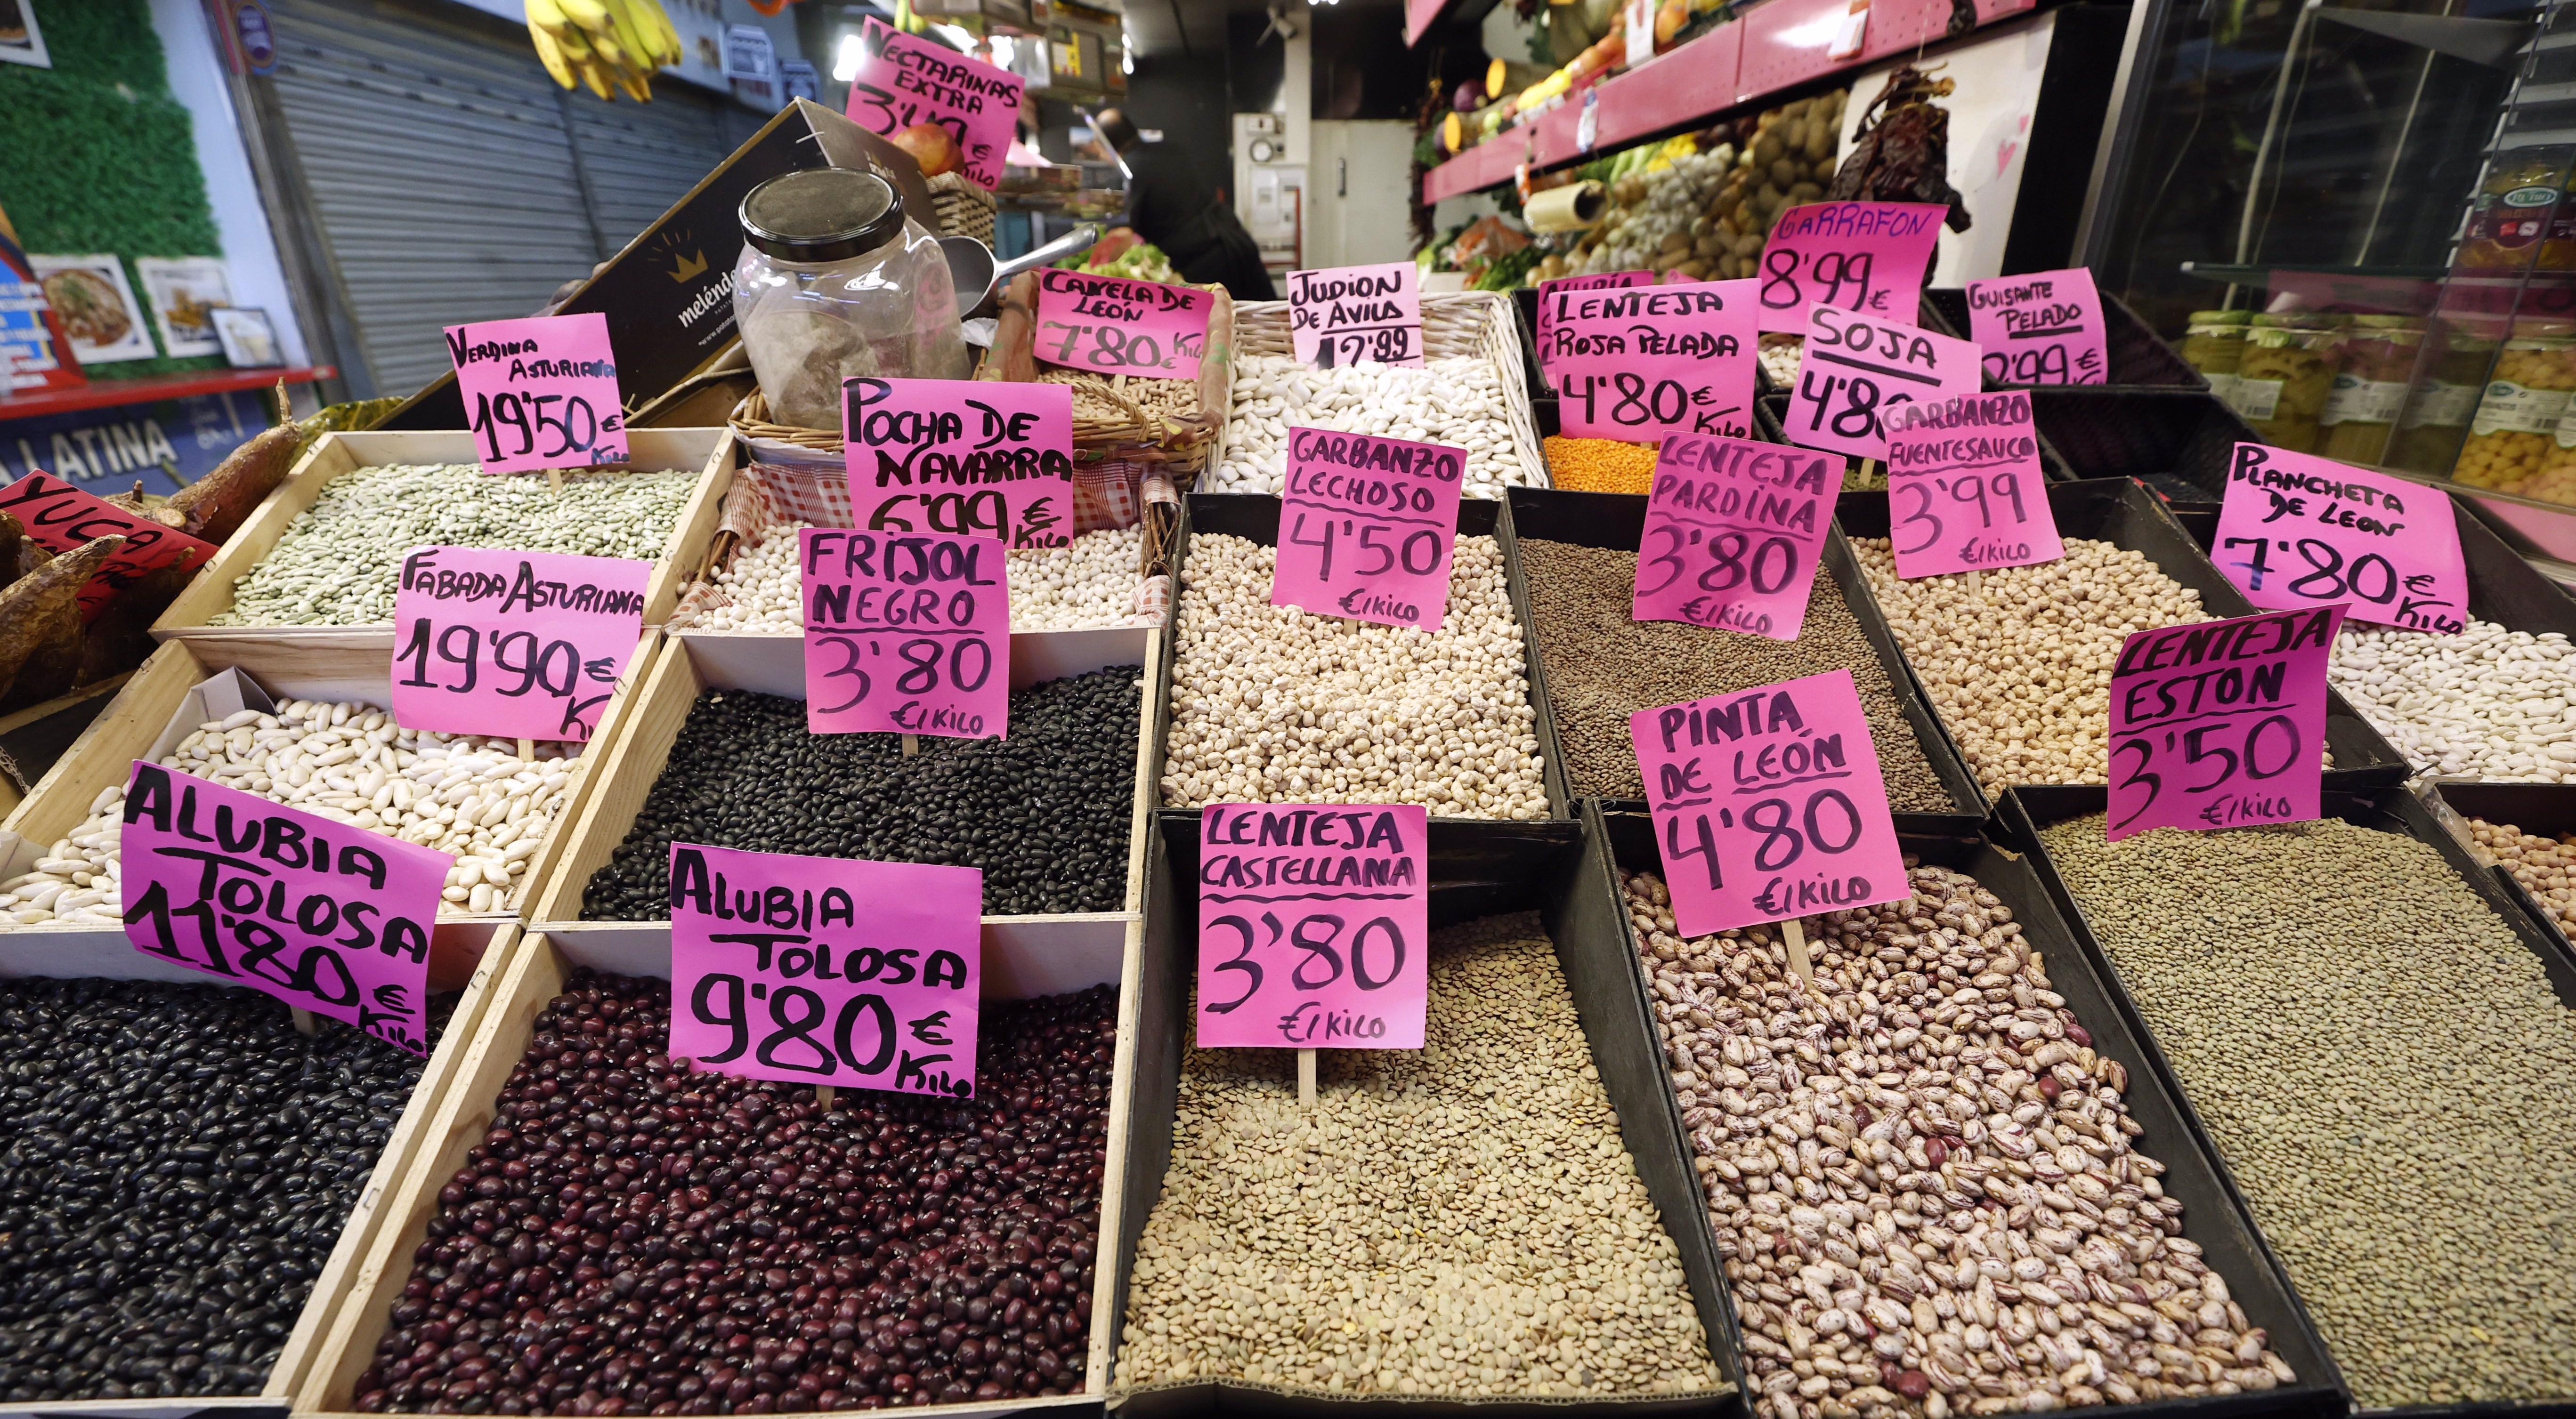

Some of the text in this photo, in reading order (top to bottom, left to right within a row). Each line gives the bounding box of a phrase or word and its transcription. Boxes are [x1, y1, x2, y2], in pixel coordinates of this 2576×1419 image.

[866, 22, 1020, 107] NECTARINAS
[895, 70, 983, 114] EXTRA
[1778, 203, 1932, 240] GARRAFON
[678, 269, 736, 329] melénd
[1158, 285, 1196, 311] DE
[1555, 291, 1723, 323] LENTEJA
[1761, 248, 1875, 312] 8'99
[1969, 282, 2053, 310] GUISANTE
[445, 327, 538, 369] VERDINA
[1042, 321, 1161, 366] 7'80
[1554, 327, 1626, 357] ROJA
[1627, 325, 1739, 359] PELADA
[1812, 307, 1937, 369] SOJA
[1996, 304, 2082, 331] PELADO
[509, 358, 616, 381] ASTURIANA
[1563, 372, 1688, 426] 4'80
[842, 377, 1040, 450] POCHA DE
[1882, 395, 2031, 432] GARBANZO
[17, 418, 179, 481] LATINA
[875, 441, 1073, 488] NAVARRA
[1294, 431, 1459, 482] GARBANZO
[1659, 435, 1828, 496] LENTEJA
[1888, 436, 2036, 467] FUENTESAUCO
[2233, 445, 2405, 515] PLANCHETA
[0, 476, 163, 555] YUCA
[1290, 466, 1435, 513] LECHOSO
[1653, 474, 1817, 534] PARDINA
[1896, 473, 2027, 555] 3'99
[2259, 487, 2406, 537] DE LEON
[807, 532, 996, 586] FRIJOL
[1289, 512, 1442, 582] 4'50
[1636, 524, 1798, 597] 3'80
[2224, 537, 2398, 605] 7'80
[402, 549, 645, 616] FABADA ASTURIANA
[812, 584, 975, 627] NEGRO
[396, 618, 580, 698] 19'90
[2112, 609, 2333, 679] LENTEJA
[814, 636, 992, 714] 3'80
[2124, 661, 2287, 725] ESTON
[1658, 690, 1804, 753] PINTA
[1659, 728, 1847, 800] DE LEÓN
[2112, 714, 2301, 831] 3'50
[122, 764, 387, 890] ALUBIA
[1207, 808, 1405, 855] LENTEJA
[1667, 788, 1863, 891] 4'80
[670, 847, 854, 933] ALUBIA
[1200, 855, 1417, 889] CASTELLANA
[152, 846, 428, 964] TOLOSA
[708, 933, 968, 990] TOLOSA
[1205, 911, 1406, 1015] 3'80
[690, 973, 897, 1076] 9'80
